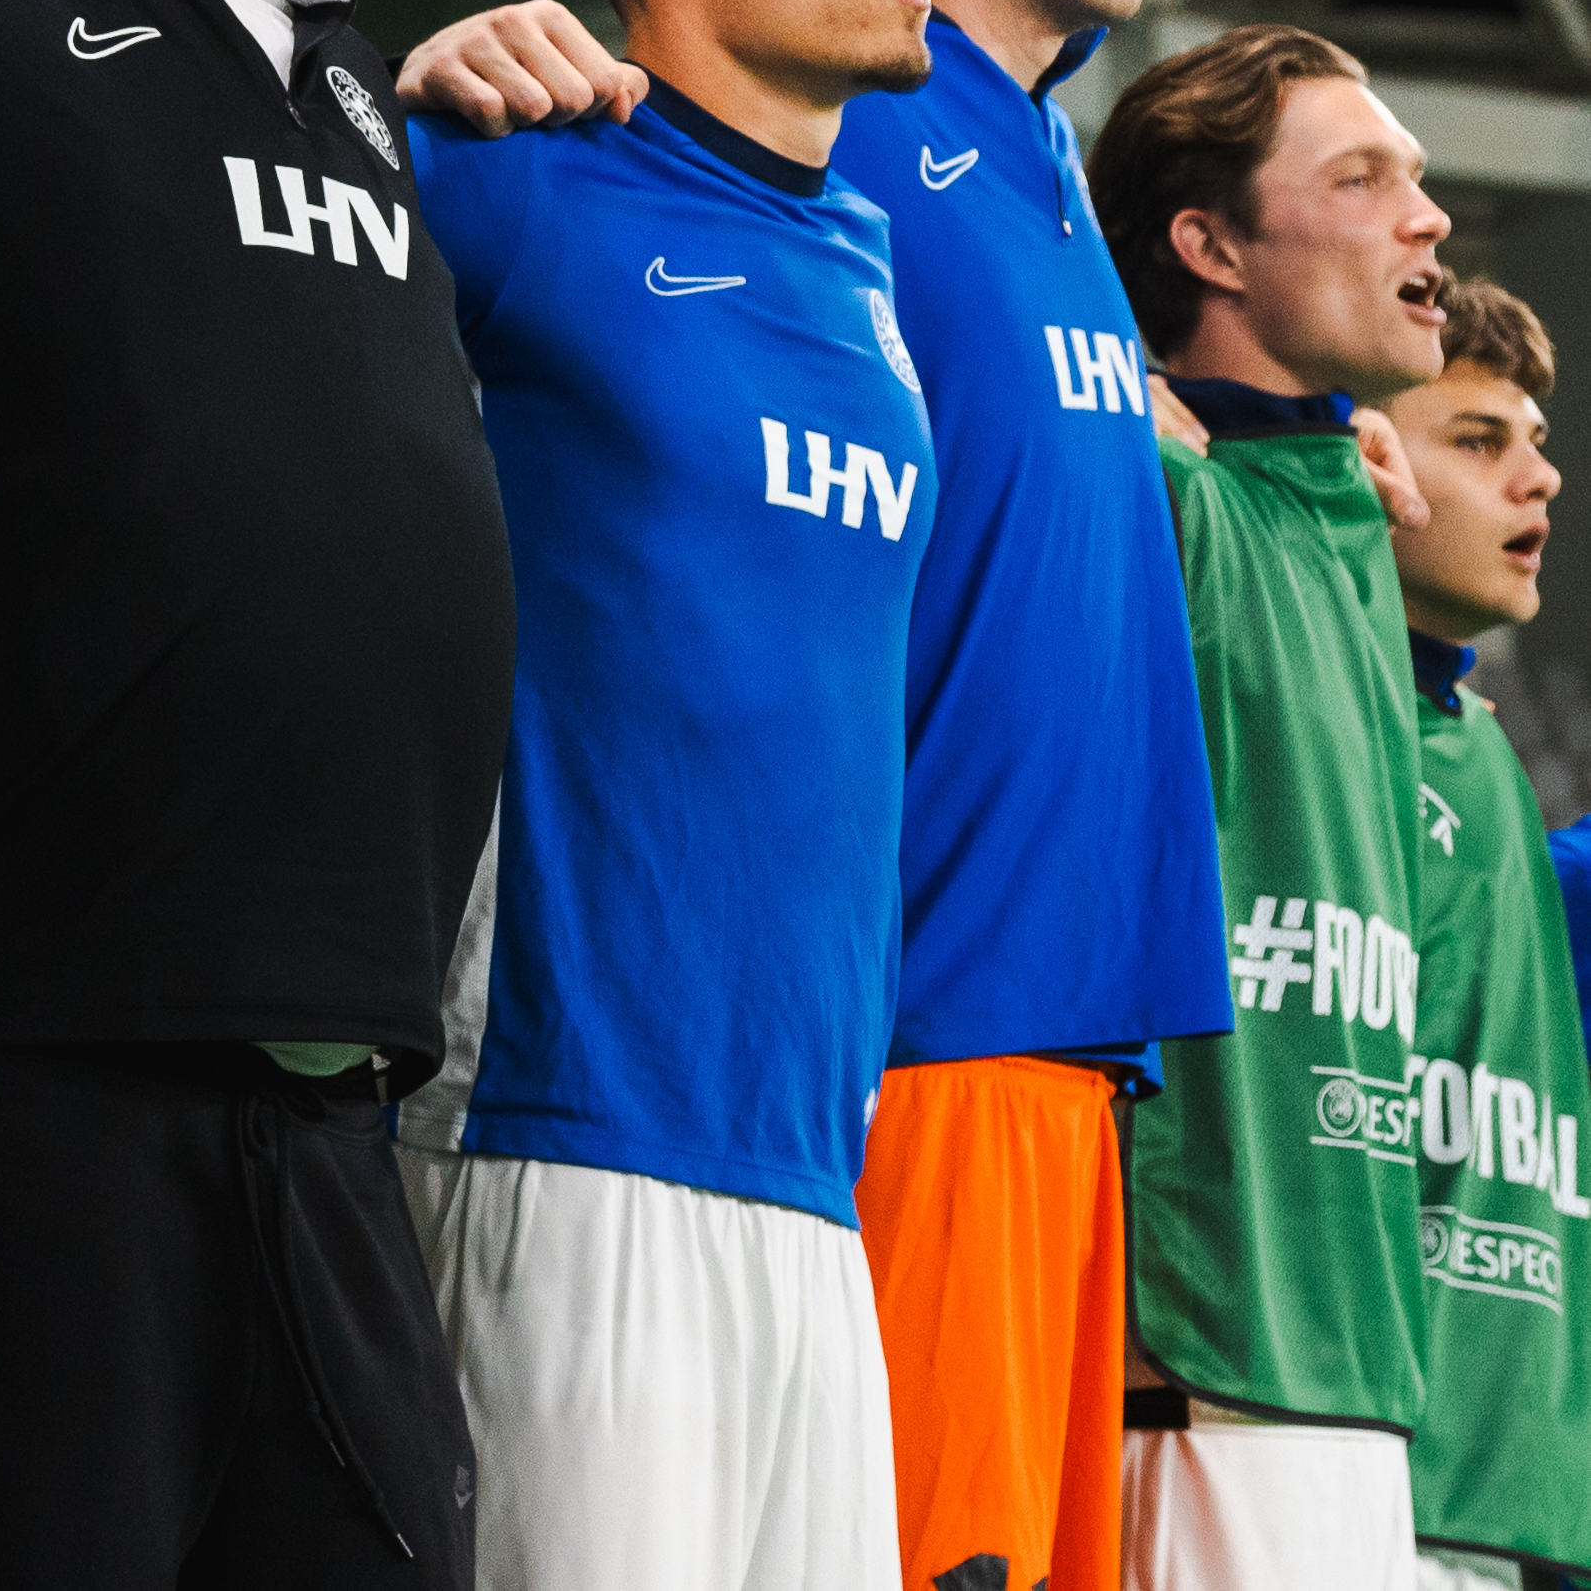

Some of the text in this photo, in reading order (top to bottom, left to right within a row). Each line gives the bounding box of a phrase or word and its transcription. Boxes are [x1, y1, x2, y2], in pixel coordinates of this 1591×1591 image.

[222, 155, 410, 281] LHV
[1043, 324, 1145, 417] LHV
[759, 416, 919, 543] LHV
